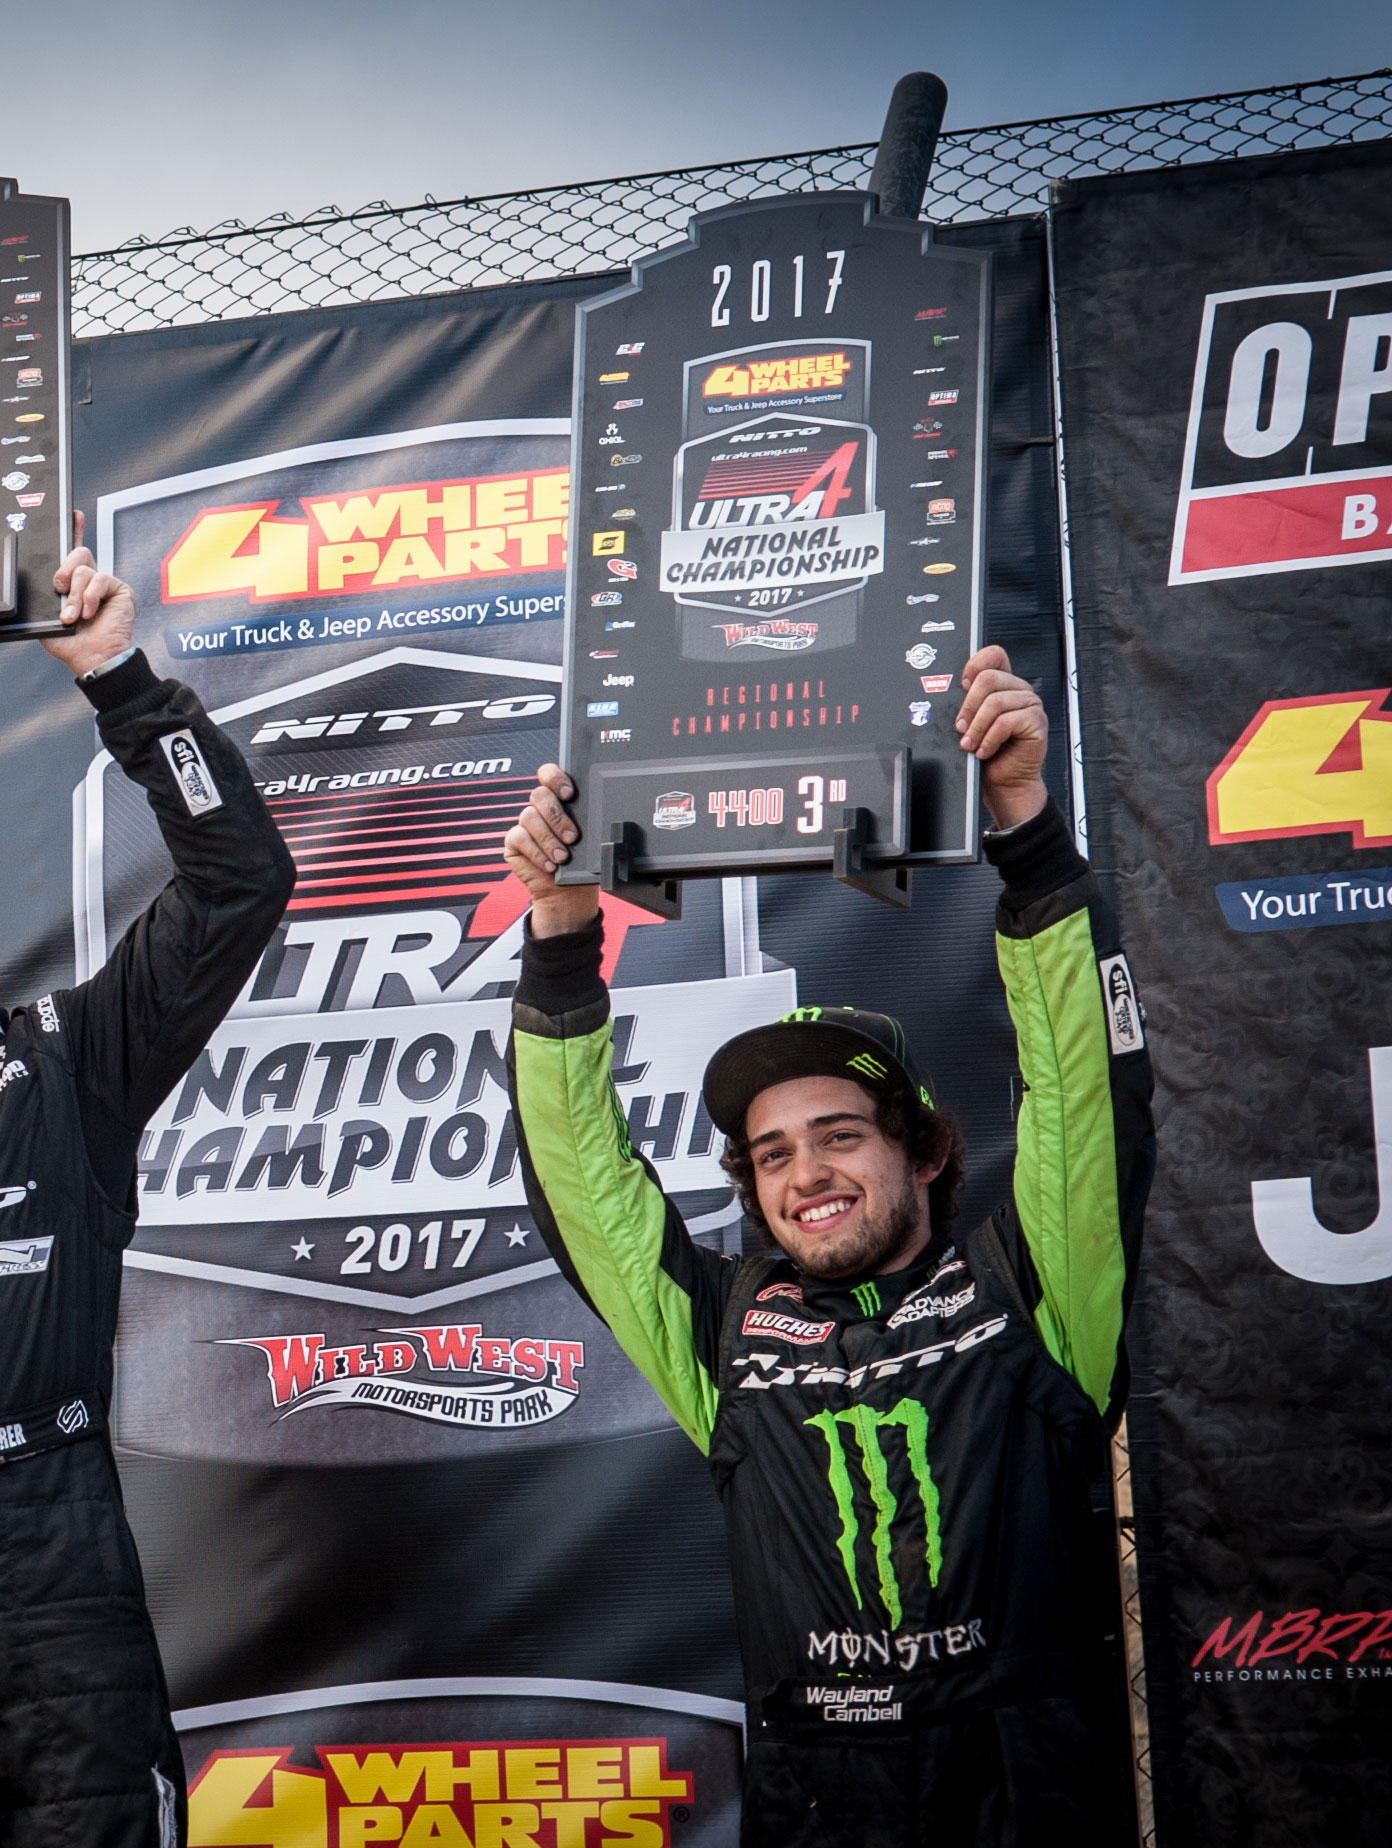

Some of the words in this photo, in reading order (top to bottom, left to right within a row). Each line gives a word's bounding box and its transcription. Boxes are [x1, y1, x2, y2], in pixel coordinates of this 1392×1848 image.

[711, 250, 845, 328] 2017
[703, 365, 750, 398] 4
[748, 353, 851, 379] WHEEL
[750, 370, 844, 395] PARTS
[728, 426, 822, 443] NITTO
[165, 505, 309, 601] 4
[311, 473, 570, 543] WHEE
[317, 519, 568, 591] PART
[700, 525, 841, 560] NATIONAL
[666, 545, 879, 585] CHAMPIONSHIP
[748, 587, 793, 607] 2017
[178, 630, 228, 652] Your
[231, 621, 293, 646] Truck
[297, 619, 315, 640] &
[319, 614, 372, 639] Jeep
[376, 601, 492, 631] Accessory
[495, 594, 567, 622] Super
[603, 674, 634, 687] Jeep
[706, 680, 825, 706] REGIONAL
[250, 693, 556, 744] NITTO
[672, 705, 859, 736] CHAMPIONSHIP
[708, 787, 784, 828] 4400
[796, 775, 847, 834] 3RD
[1240, 889, 1322, 921] Your
[341, 1218, 486, 1275] 2017
[748, 1312, 830, 1337] HUGHES
[238, 1334, 418, 1408] WILD
[403, 1323, 584, 1396] WEST
[350, 1382, 494, 1423] MOTORSPORTS
[500, 1389, 553, 1424] PARK
[808, 1617, 987, 1673] MONSTER
[1194, 1667, 1334, 1684] PERFORMANCE
[806, 1685, 894, 1709] Wayland
[824, 1702, 903, 1722] Cambell
[185, 1751, 327, 1848] 4
[325, 1744, 688, 1804] WHEEL
[338, 1799, 664, 1848] PARTS
